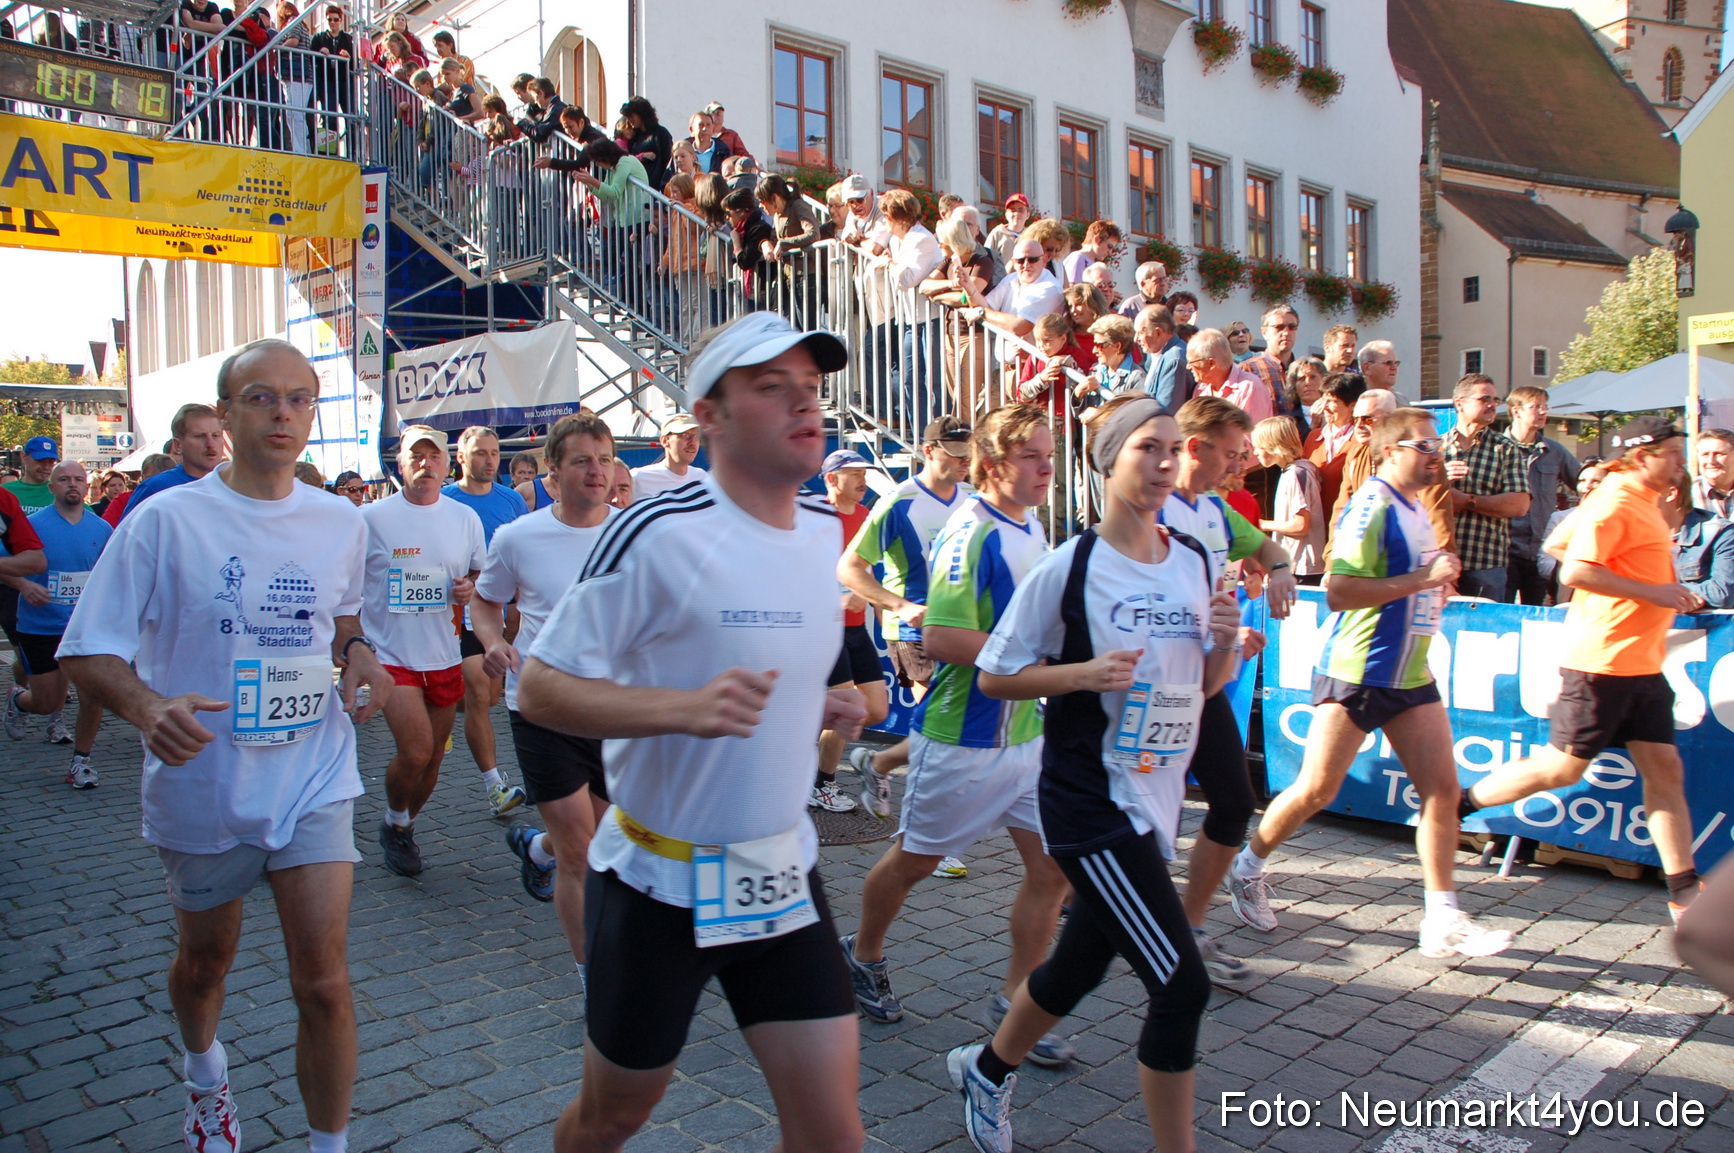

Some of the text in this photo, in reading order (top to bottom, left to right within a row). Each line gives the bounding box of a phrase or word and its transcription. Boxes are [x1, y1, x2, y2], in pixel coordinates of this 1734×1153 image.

[57, 54, 163, 81] Sportstätteneinrichtungen
[1, 136, 154, 203] ART
[196, 189, 328, 212] Neumarkter Stadtlauf
[136, 225, 253, 244] Neumarkter Stadtlauf
[397, 352, 487, 404] BOCK
[393, 547, 421, 556] MERZ
[61, 574, 73, 582] Udo
[404, 572, 430, 581] Walter
[61, 586, 84, 596] 233
[406, 588, 443, 600] 2685
[266, 593, 317, 605] 16.09.2007
[243, 624, 314, 636] Neumarkter
[257, 636, 313, 647] Stadtlauf
[267, 666, 303, 682] Hans-
[241, 692, 248, 706] B
[268, 692, 325, 721] 2337
